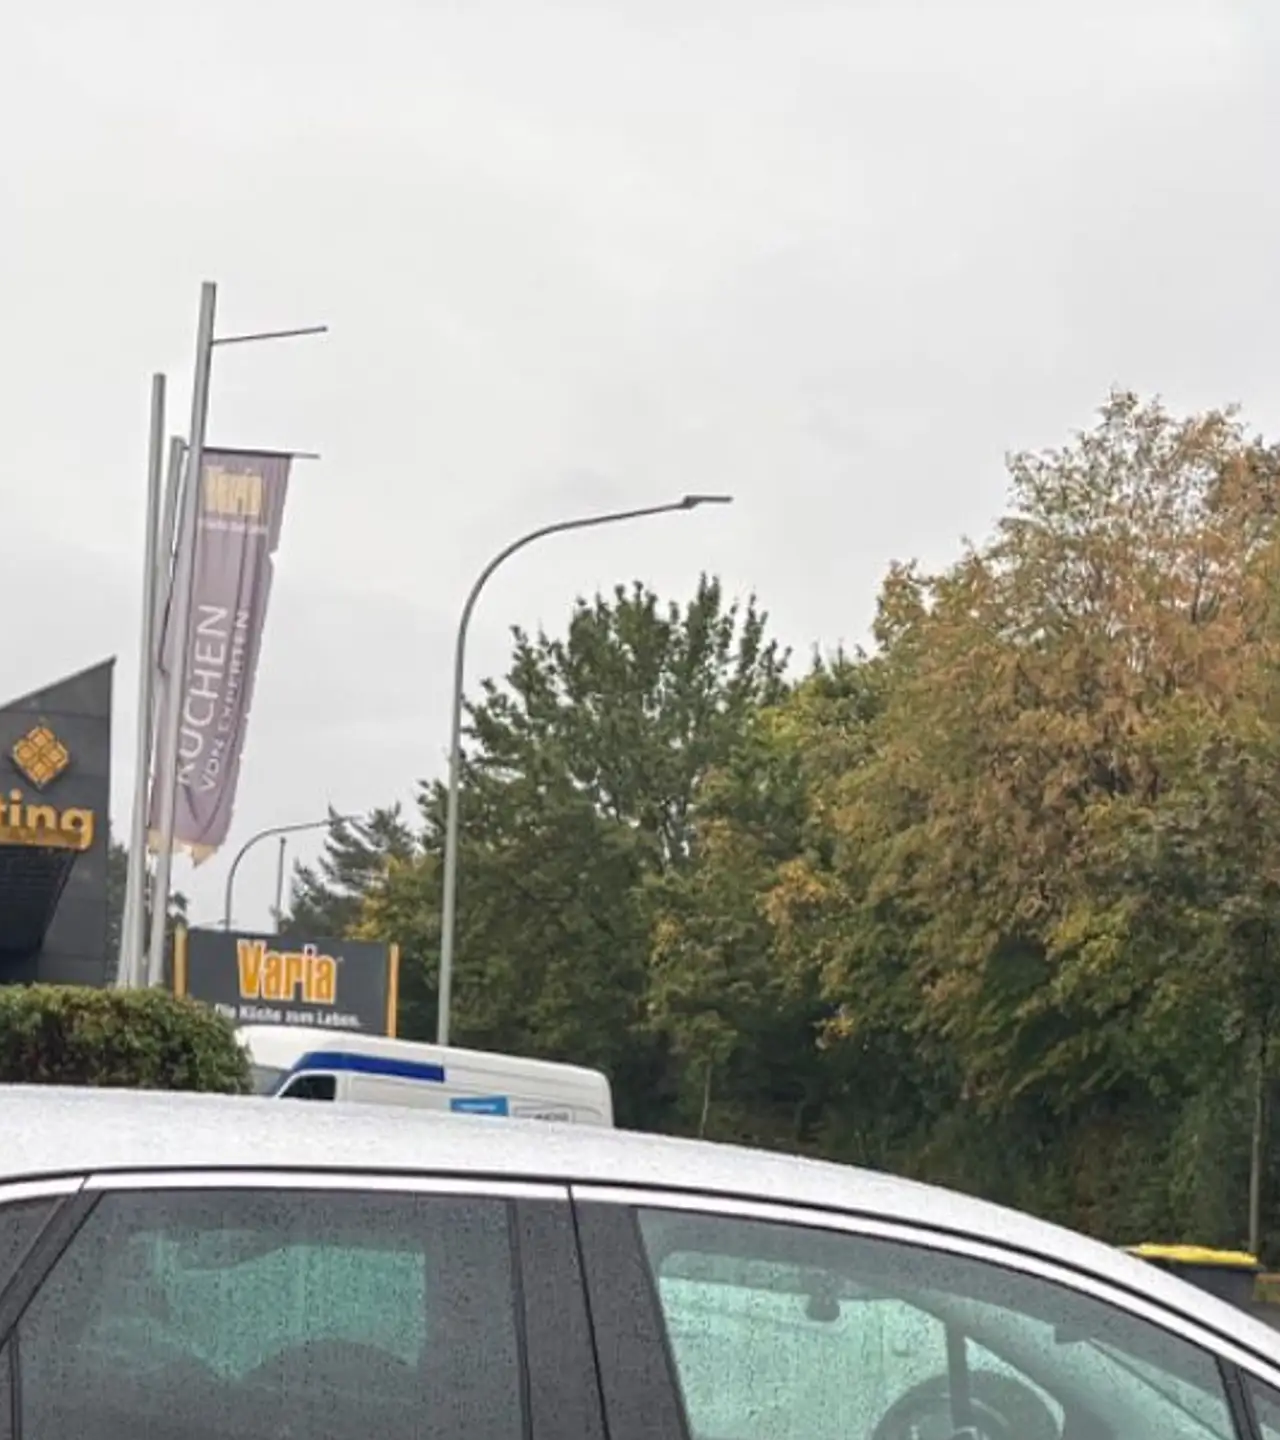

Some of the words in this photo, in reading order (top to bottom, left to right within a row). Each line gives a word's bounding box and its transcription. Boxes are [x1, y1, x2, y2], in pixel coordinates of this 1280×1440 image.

[237, 938, 338, 1004] Varia
[239, 1004, 282, 1022] Küche
[285, 1010, 314, 1024] zum
